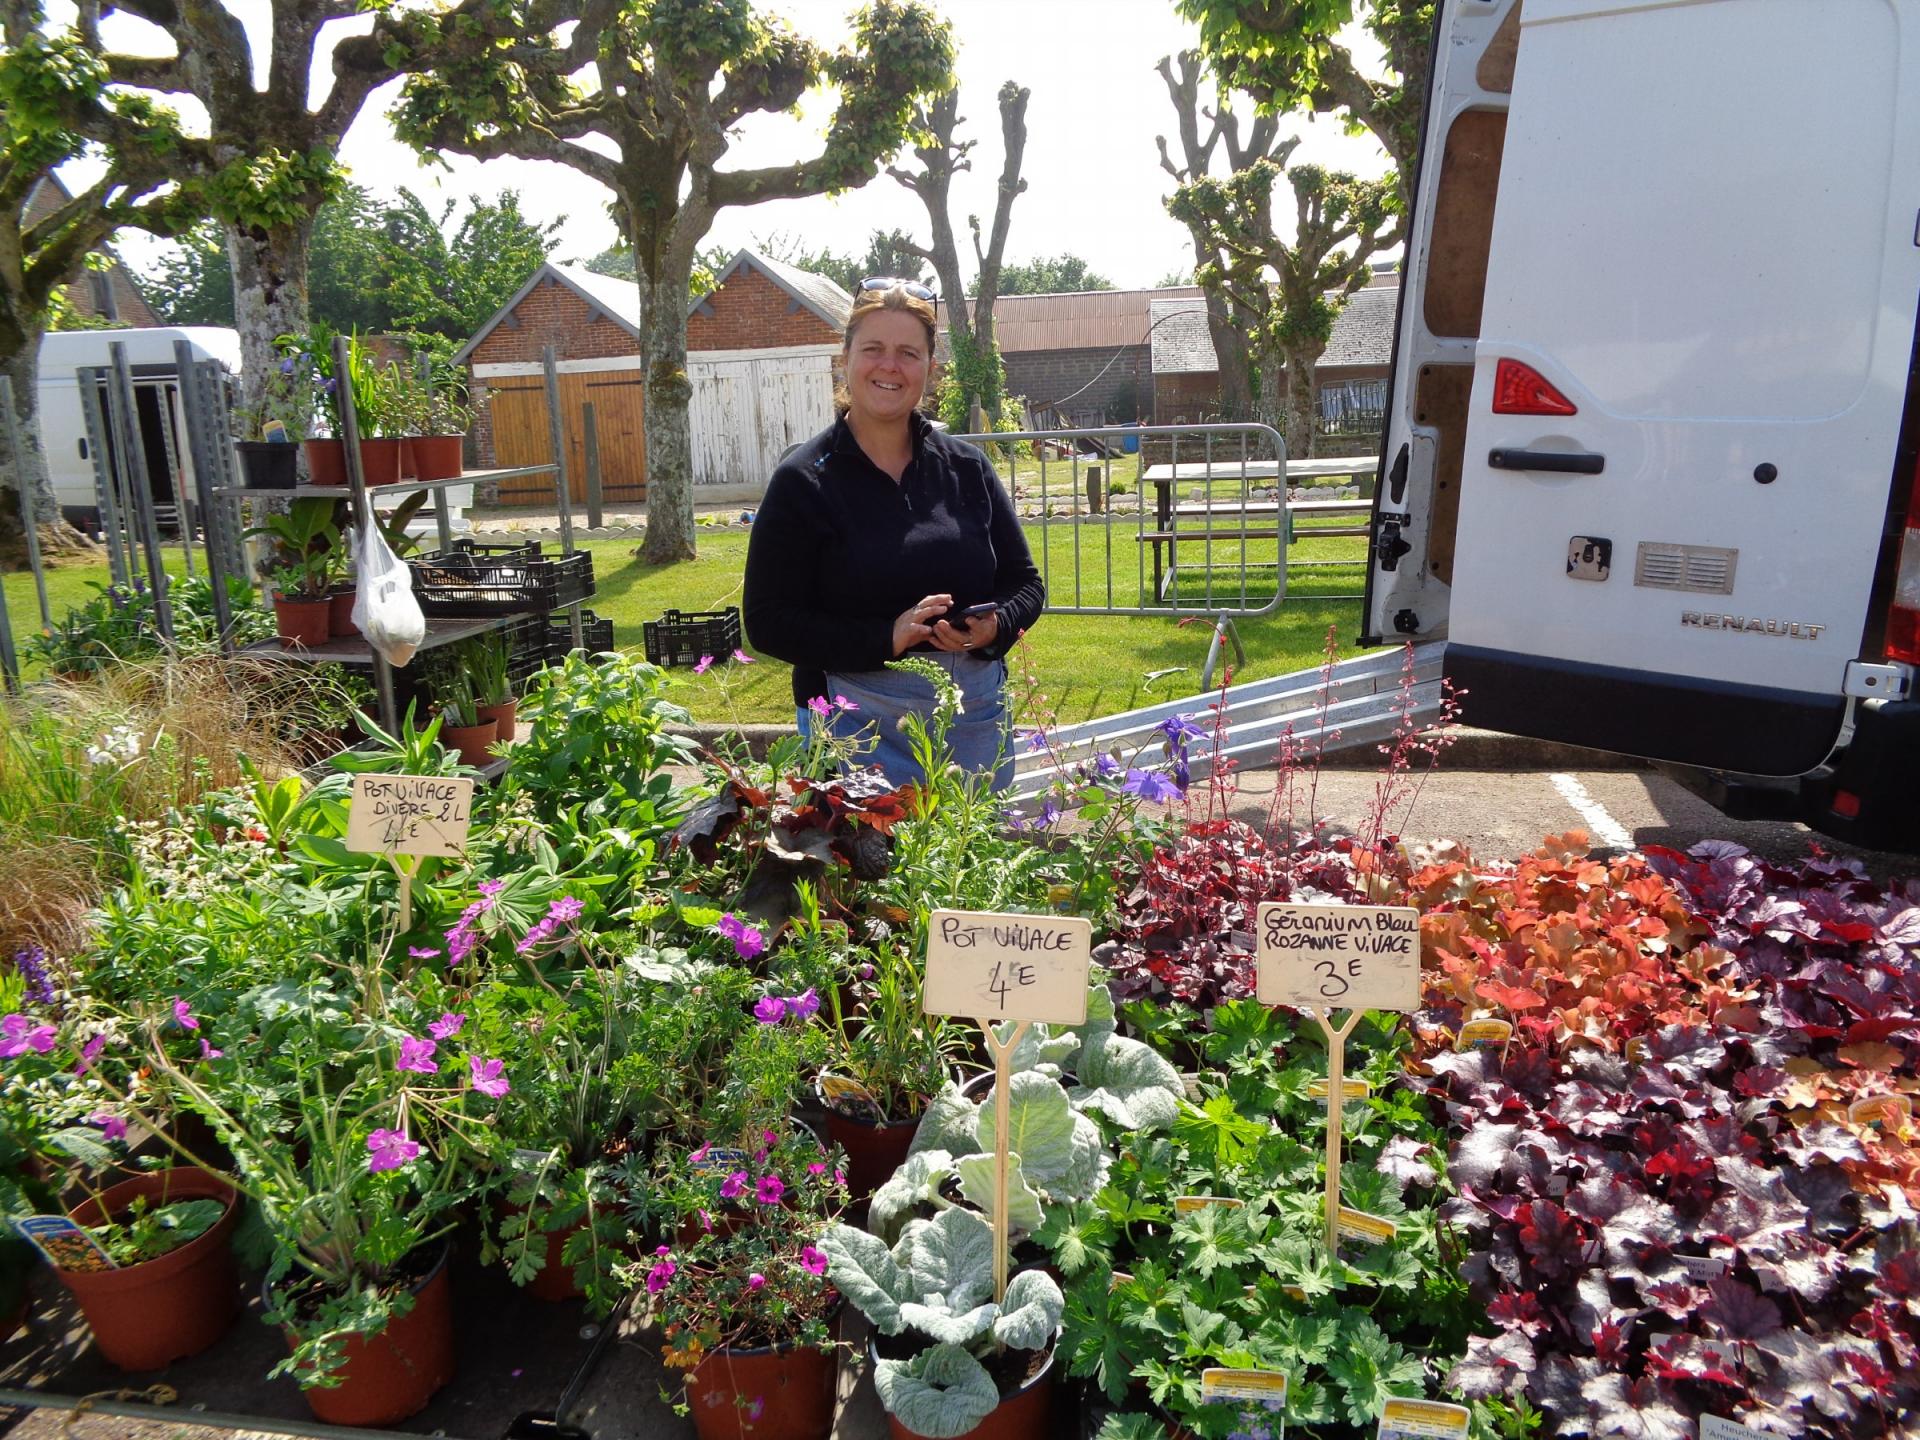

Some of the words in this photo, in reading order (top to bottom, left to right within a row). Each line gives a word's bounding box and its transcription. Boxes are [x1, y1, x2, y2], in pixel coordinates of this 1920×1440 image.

[1681, 610, 1826, 640] RENAULT
[1376, 913, 1419, 932] Bleu
[1265, 930, 1348, 950] ROZANNE
